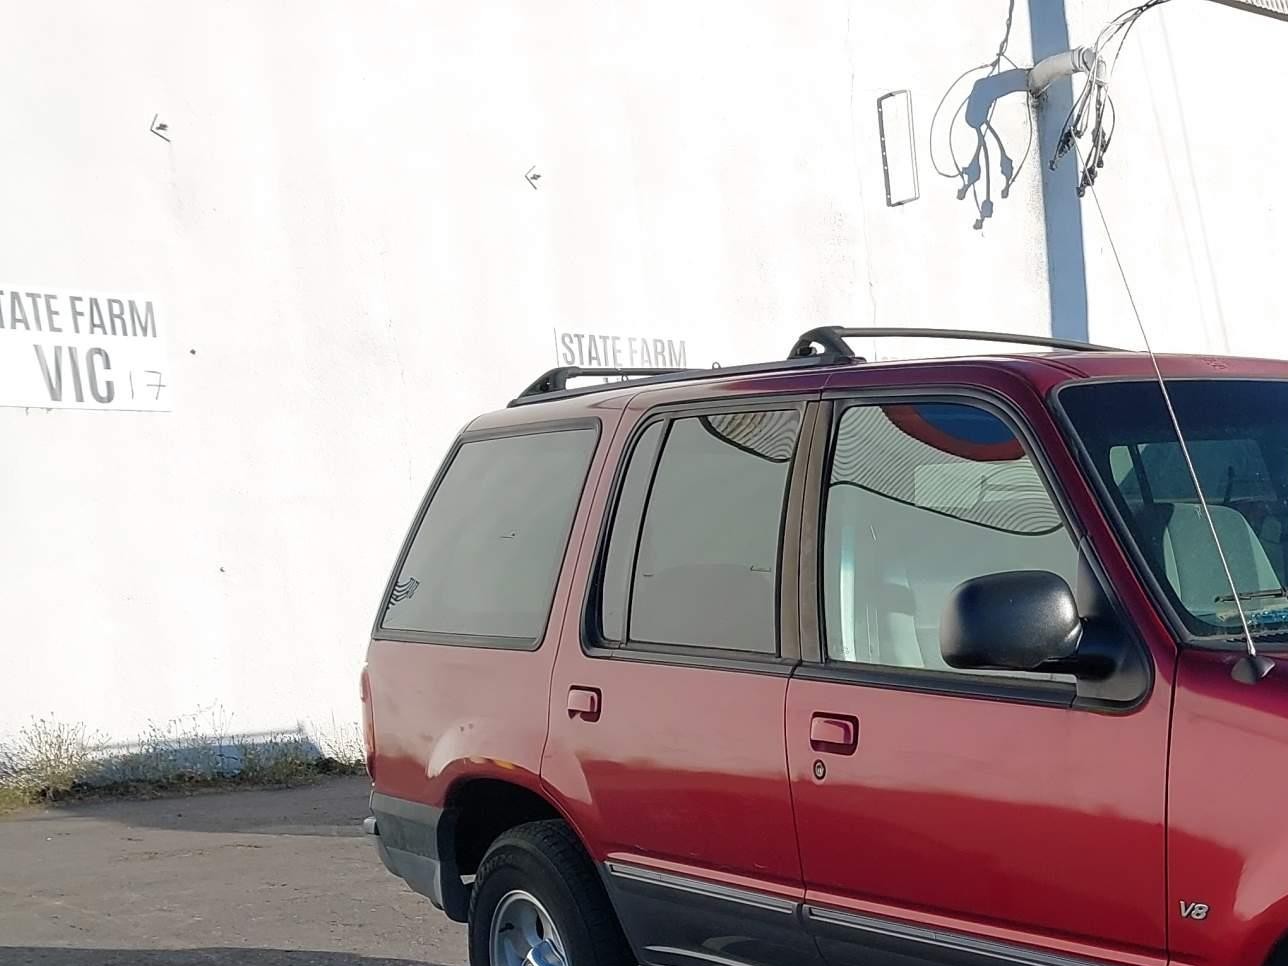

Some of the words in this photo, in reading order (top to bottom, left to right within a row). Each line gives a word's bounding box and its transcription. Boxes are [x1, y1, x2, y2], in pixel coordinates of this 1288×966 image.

[69, 295, 158, 338] FARM
[561, 333, 624, 369] STATE
[628, 337, 687, 368] FARM
[33, 344, 115, 404] VIC
[1179, 900, 1208, 920] V8
